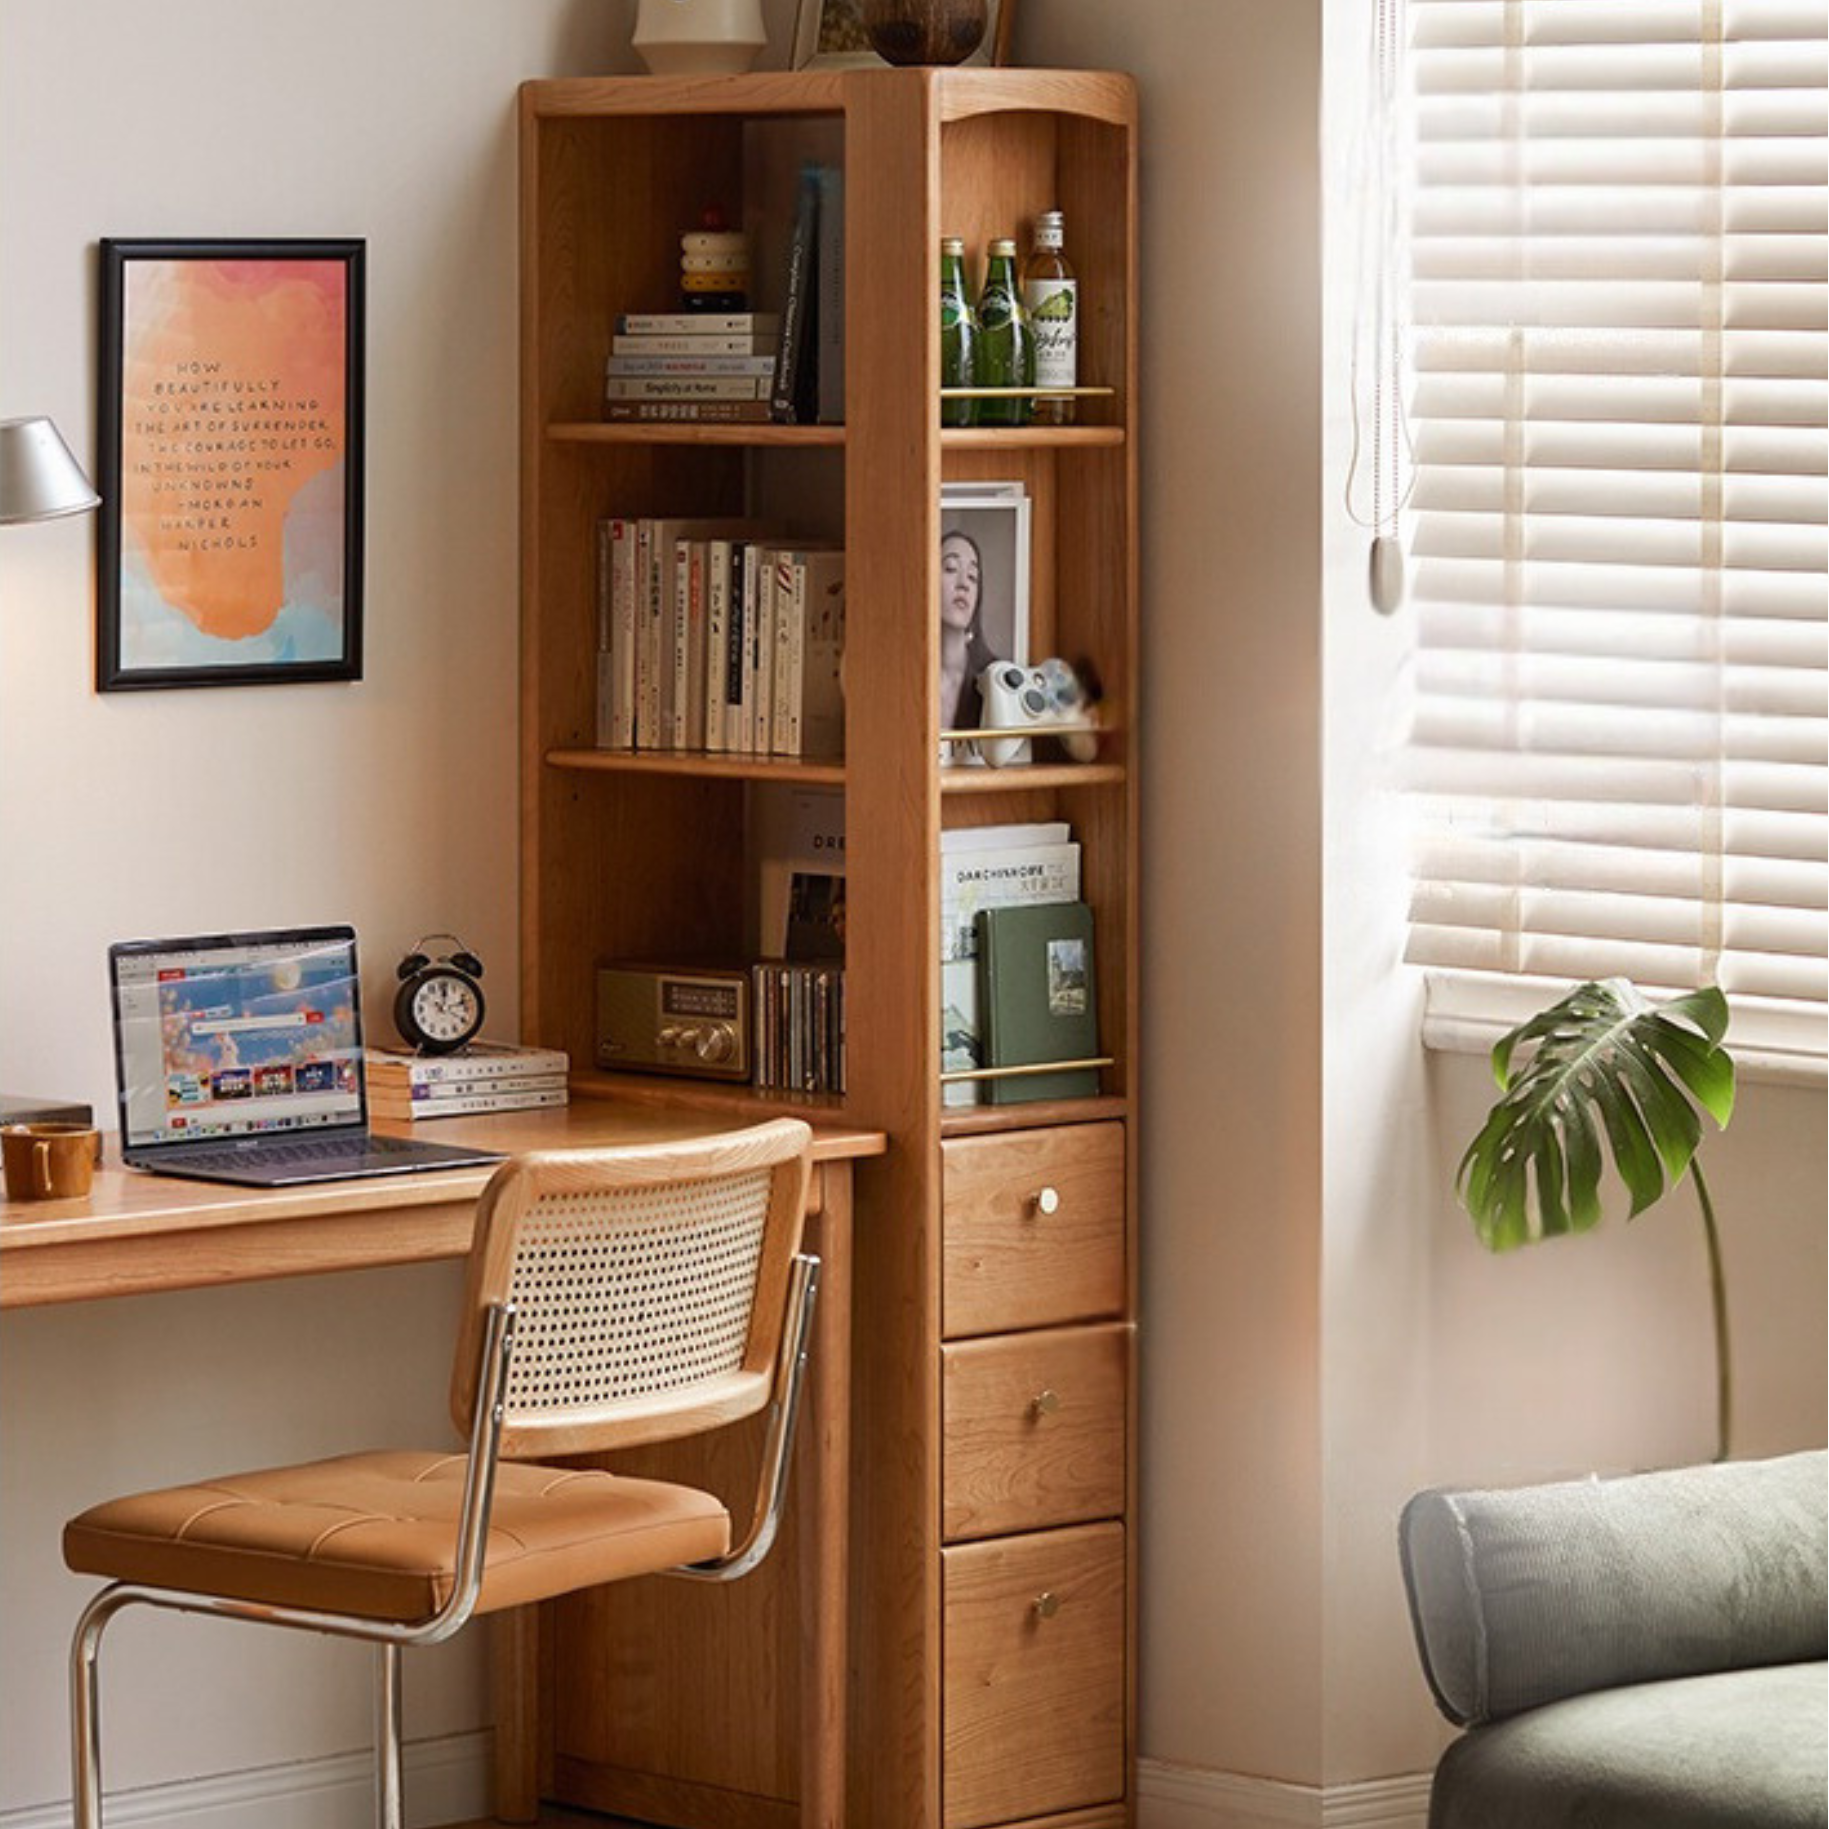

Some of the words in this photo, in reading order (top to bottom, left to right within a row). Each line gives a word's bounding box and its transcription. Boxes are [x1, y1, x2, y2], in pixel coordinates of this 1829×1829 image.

[177, 362, 221, 375] HOW
[154, 380, 280, 395] BEAUTIFULLY
[146, 402, 184, 414] YOU
[189, 401, 221, 414] ARE
[227, 400, 320, 414] LEARNING
[136, 420, 165, 434] THE
[173, 420, 201, 433] ART
[207, 419, 226, 432] OF
[150, 442, 178, 453] THE
[186, 438, 257, 453] COURAGE
[261, 437, 279, 450] TO
[282, 436, 308, 450] LET
[133, 463, 150, 474] IN
[153, 462, 183, 474] THE
[186, 461, 226, 473] WILD
[231, 461, 251, 472] OF
[256, 459, 292, 471] YOUR
[152, 477, 255, 493] UNKNOWNS
[161, 516, 230, 530] HARPER
[178, 535, 259, 551] NICHOLS
